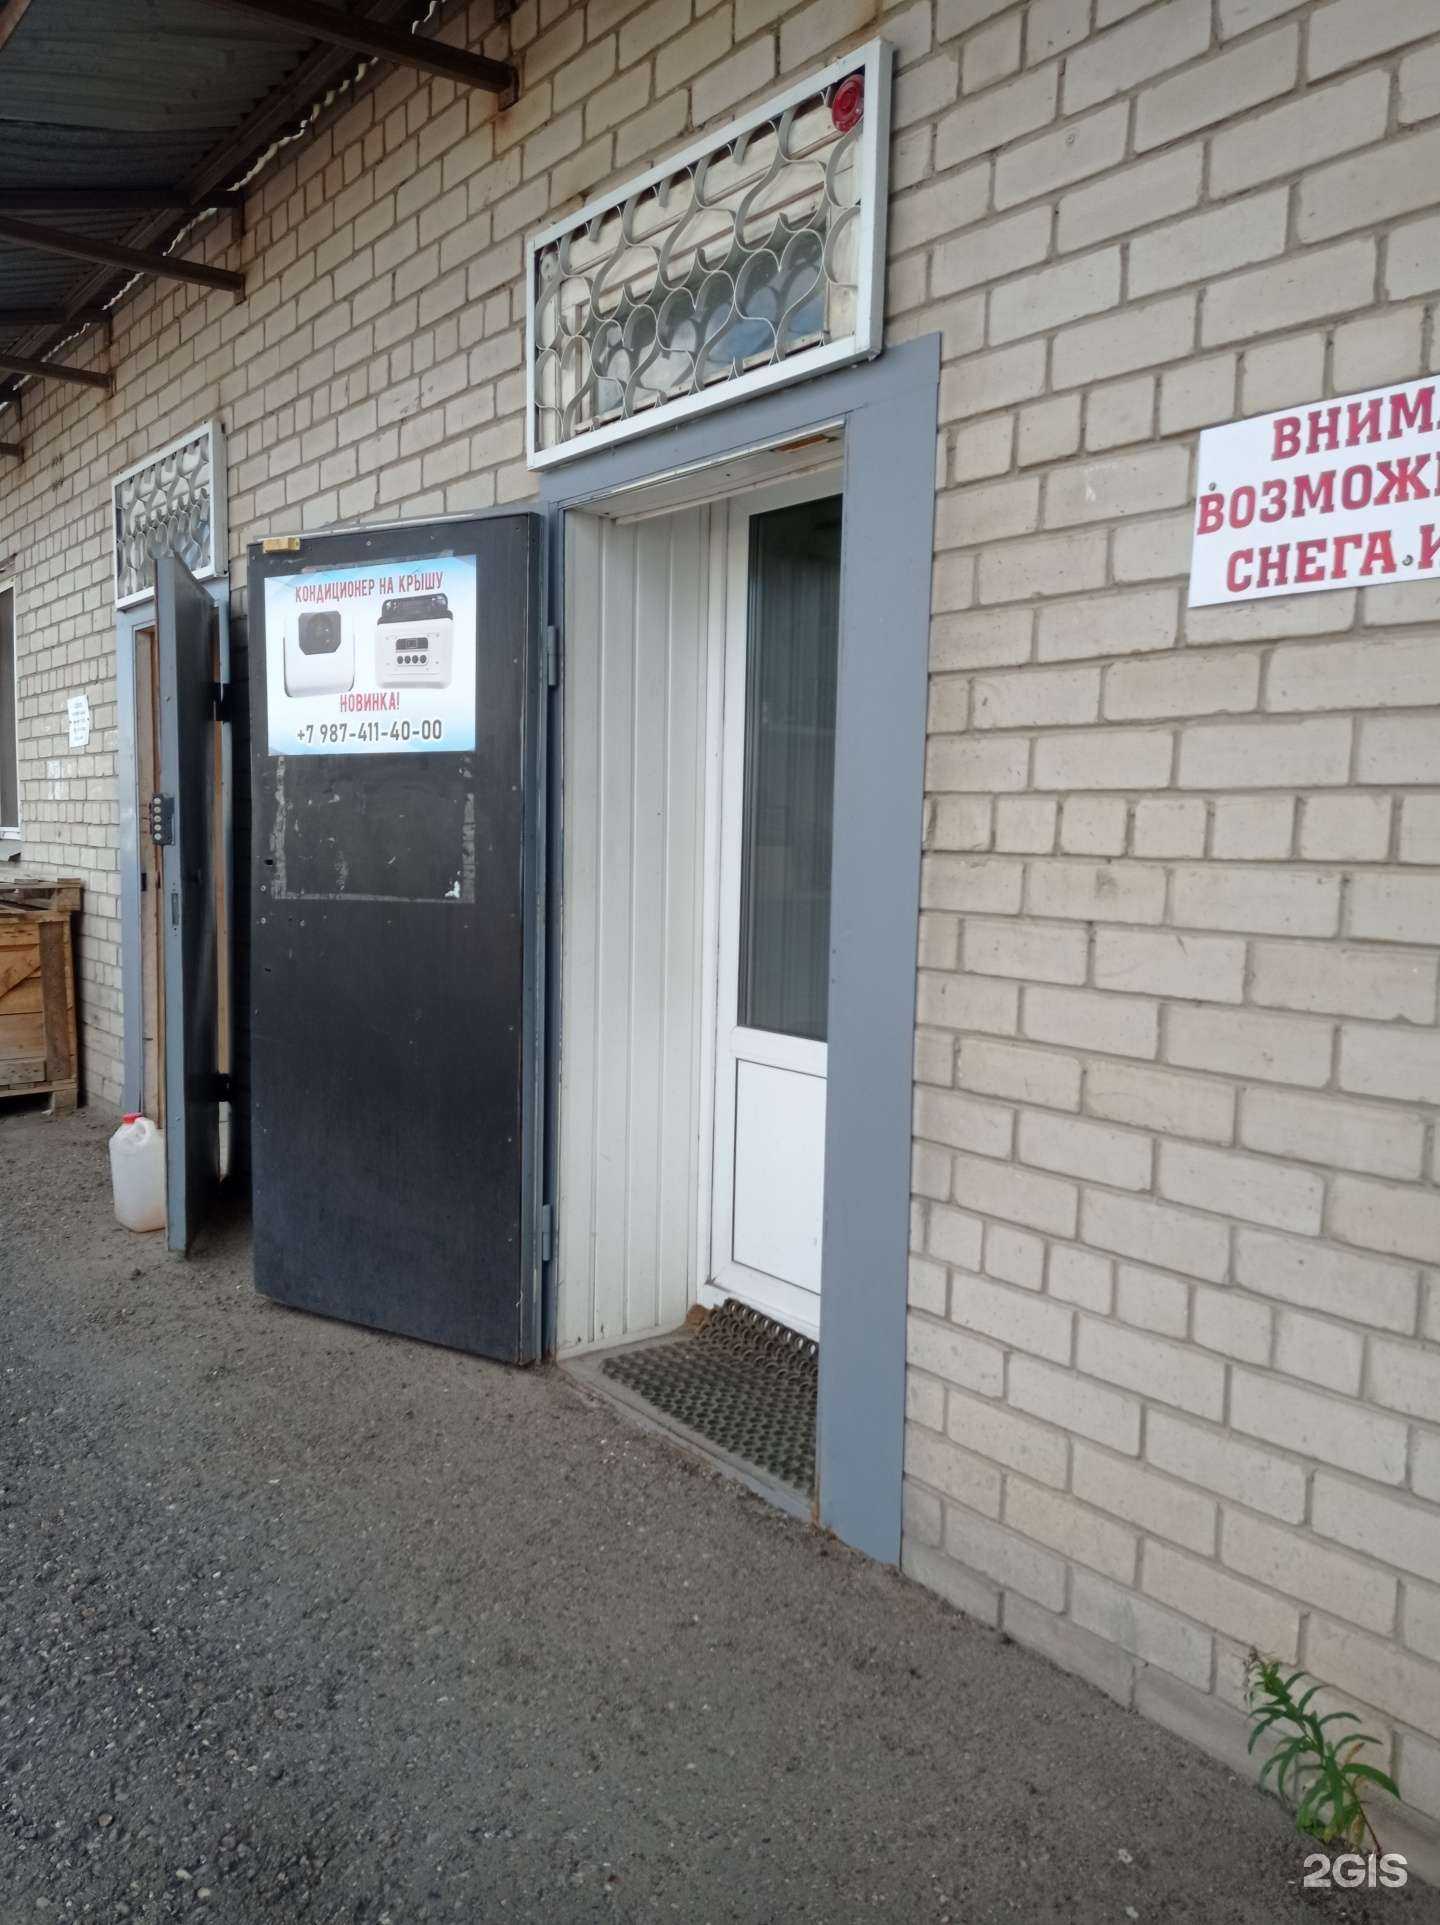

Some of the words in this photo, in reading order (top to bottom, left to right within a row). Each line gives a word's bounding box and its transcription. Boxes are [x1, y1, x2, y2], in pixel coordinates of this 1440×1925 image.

[1271, 386, 1440, 461] ВНИМ
[1197, 453, 1440, 535] ВОЗМОЖ
[1226, 529, 1397, 593] СНЕГА
[295, 578, 375, 604] КОНДИЦИОНЕР
[379, 577, 393, 594] НА
[399, 572, 443, 593] КРЫШУ
[340, 692, 400, 713] НОВИНКА!
[297, 724, 313, 744] +7
[320, 719, 442, 743] 987-411-40-00
